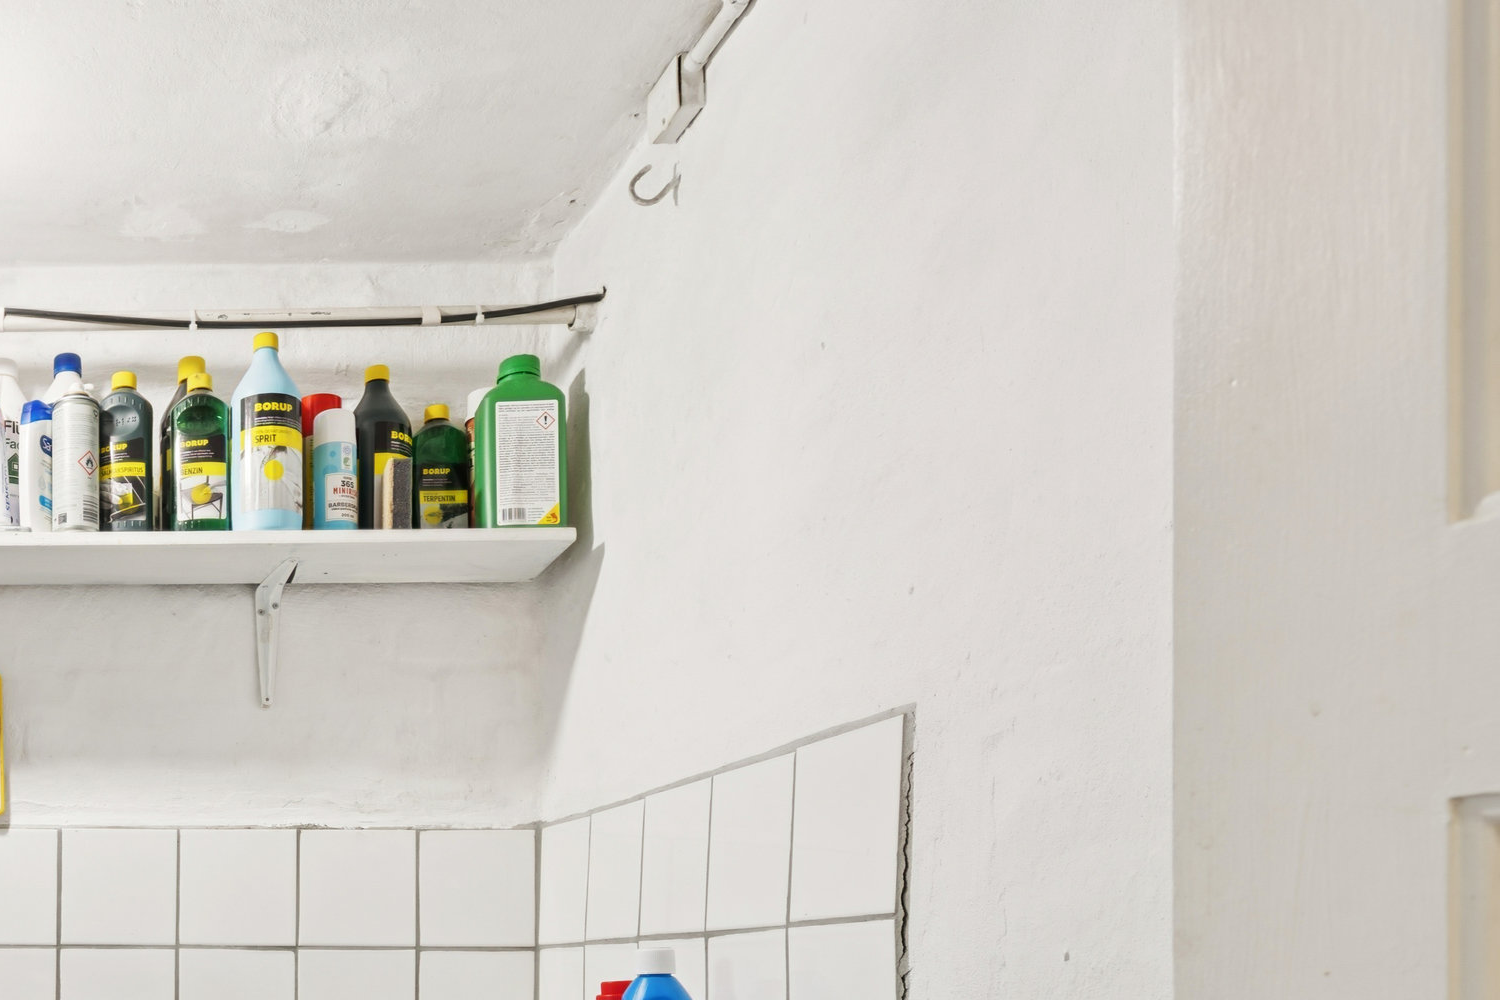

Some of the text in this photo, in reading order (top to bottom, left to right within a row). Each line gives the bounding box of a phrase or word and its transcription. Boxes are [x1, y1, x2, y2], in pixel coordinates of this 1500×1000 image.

[254, 402, 293, 412] BORUP
[181, 439, 209, 448] BORUP
[255, 434, 277, 444] SPRIT
[100, 443, 128, 454] BORUP
[422, 467, 451, 475] BORUP
